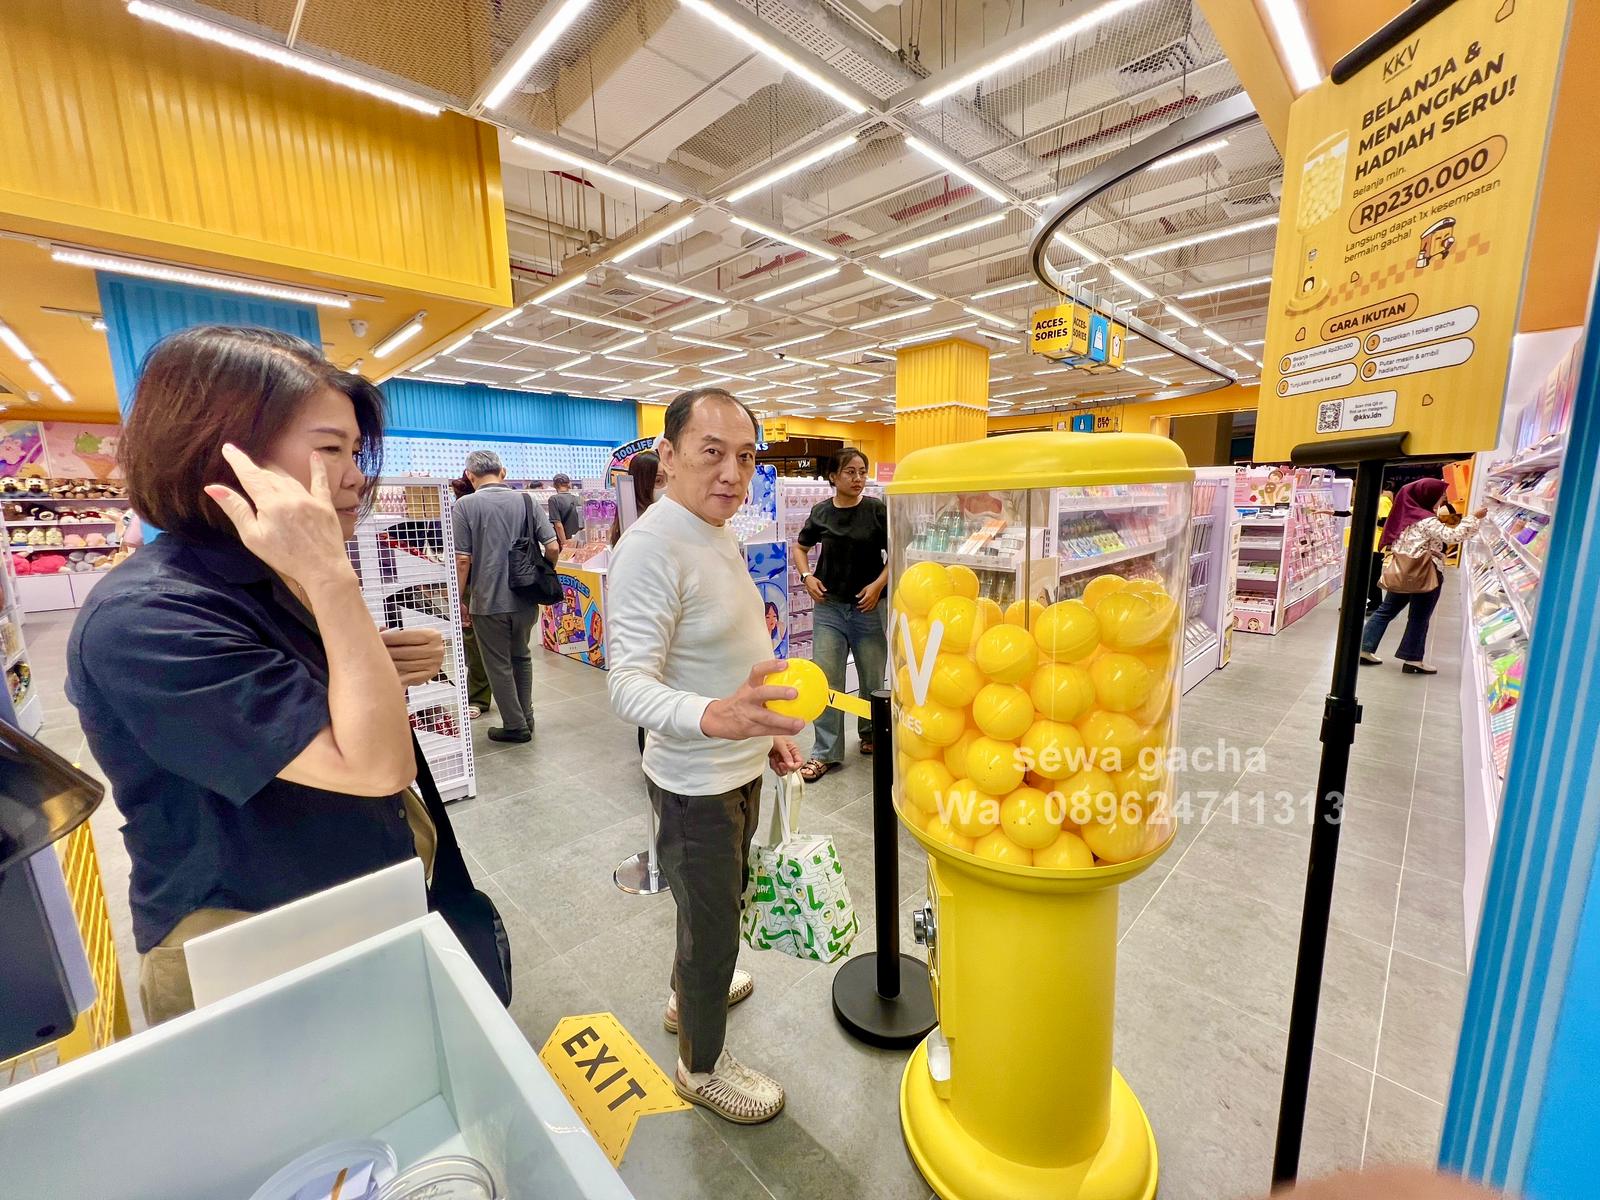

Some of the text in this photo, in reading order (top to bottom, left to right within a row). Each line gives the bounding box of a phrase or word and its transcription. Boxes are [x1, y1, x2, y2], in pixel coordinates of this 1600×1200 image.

[1382, 38, 1420, 81] KKV
[1357, 52, 1506, 156] MENANGKAN
[1361, 57, 1457, 131] BELANJA
[1464, 40, 1482, 64] &
[1354, 74, 1518, 181] HADIAH SERU!
[1352, 166, 1407, 199] Belanja min.
[1359, 147, 1489, 227] Rp230.000
[1345, 179, 1501, 253] Langsung dapat 1x kesempatan
[1344, 229, 1412, 264] bermain gacha!
[1035, 317, 1068, 331] ACCES-
[1035, 328, 1068, 341] SORIES
[1329, 302, 1407, 334] CARA IKUTAN
[1415, 325, 1434, 335] token
[1434, 320, 1456, 332] gacha
[1353, 411, 1382, 422] @kkv.idn
[561, 1025, 647, 1112] EXIT
